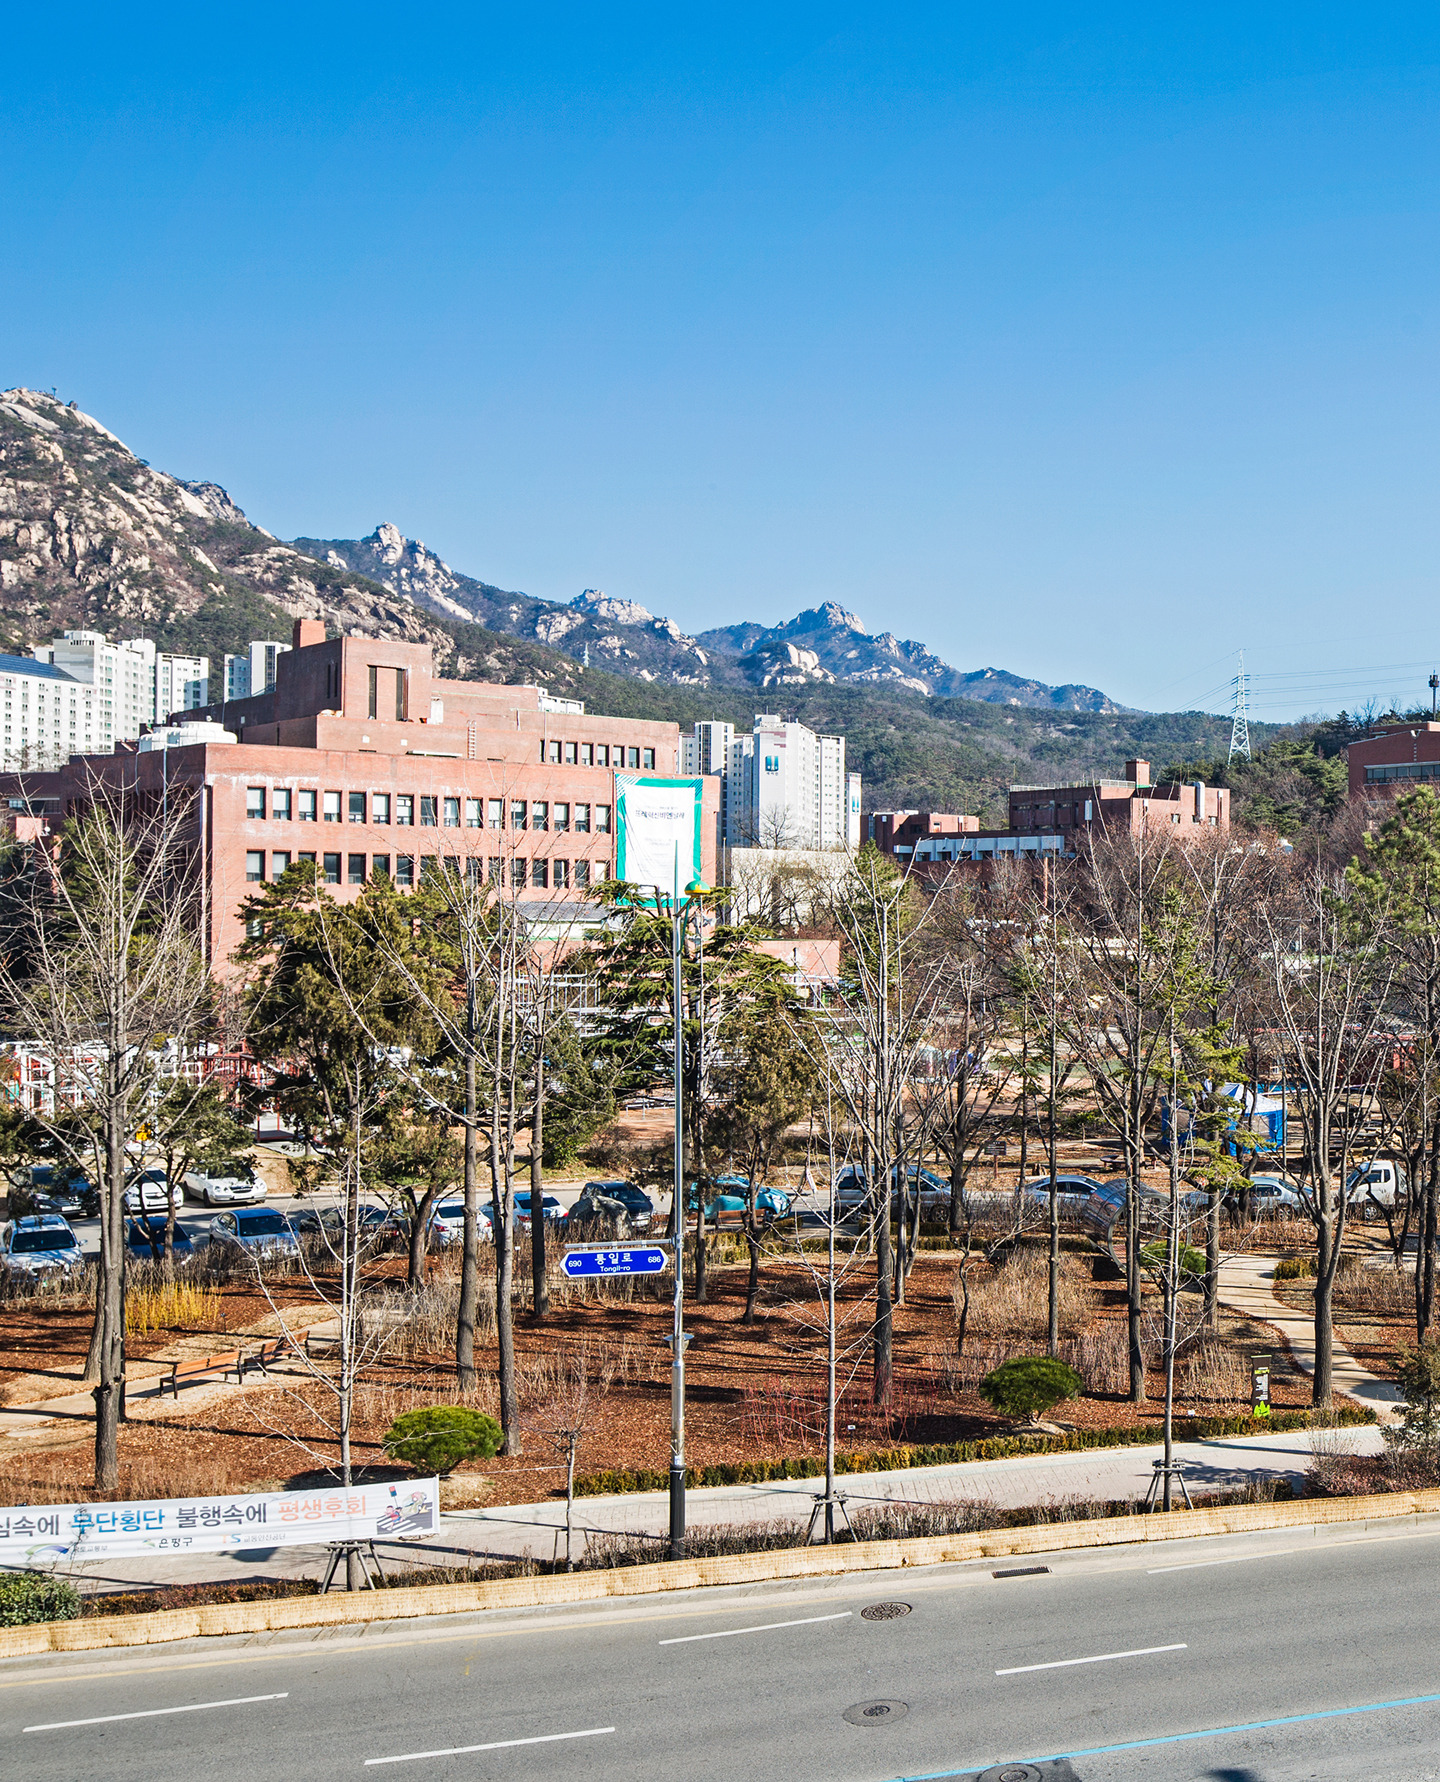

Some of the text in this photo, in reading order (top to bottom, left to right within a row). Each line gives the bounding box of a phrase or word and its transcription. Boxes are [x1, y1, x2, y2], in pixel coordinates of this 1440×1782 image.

[595, 1252, 633, 1265] 통일로
[600, 1265, 631, 1273] Tongil-ro
[71, 1508, 165, 1535] 무단횡단
[176, 1502, 267, 1529] 불행속에
[278, 1495, 367, 1522] 평생후회
[158, 1537, 193, 1549] 은평구
[220, 1533, 242, 1544] TS
